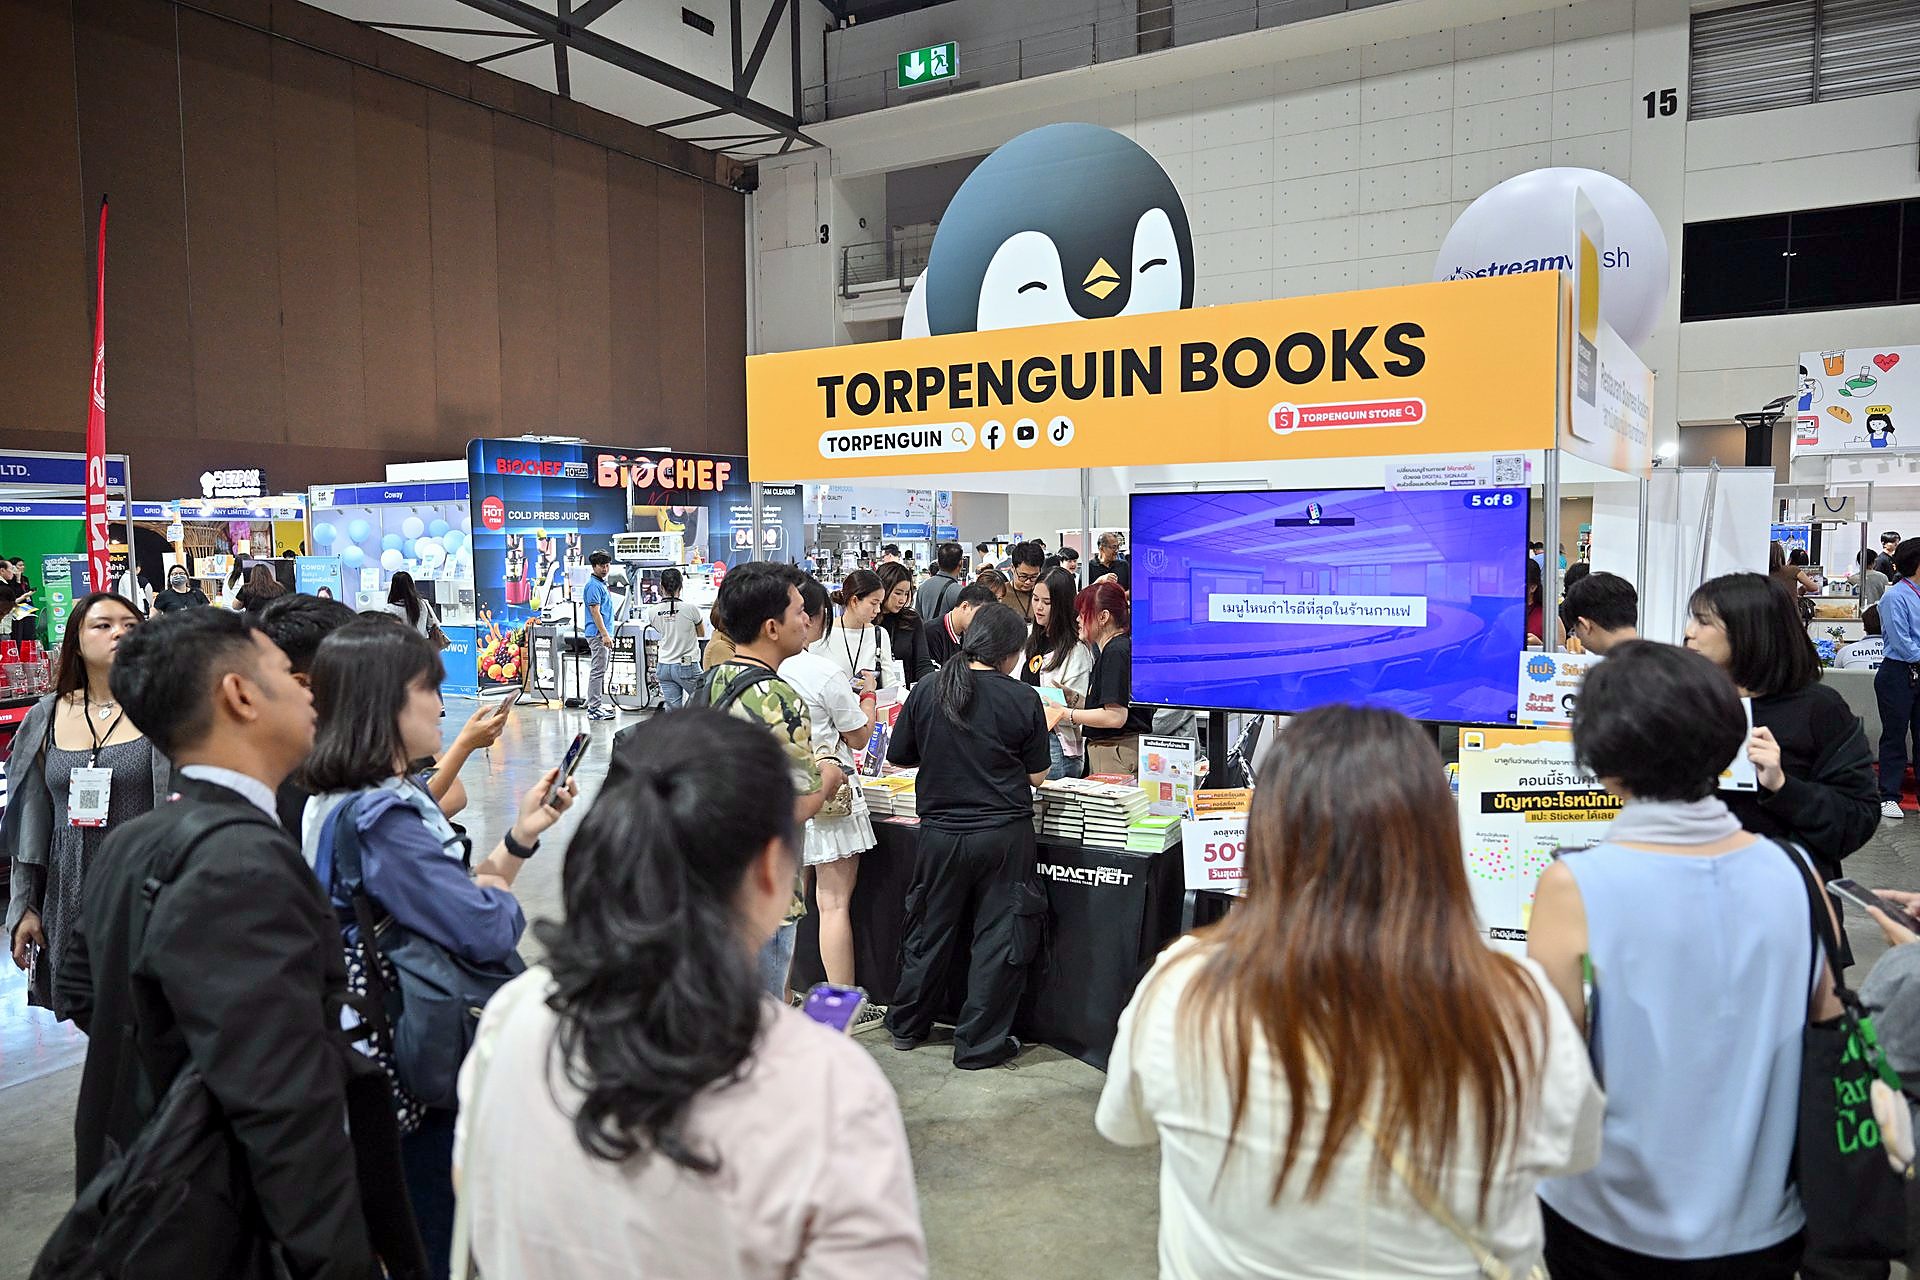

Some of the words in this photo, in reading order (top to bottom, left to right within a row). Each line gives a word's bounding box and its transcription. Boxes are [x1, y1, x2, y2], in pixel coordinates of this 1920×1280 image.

[1642, 87, 1678, 119] 15
[820, 224, 830, 245] 3
[817, 345, 1162, 419] TORPENGUIN
[1180, 321, 1427, 393] BOOKS
[1302, 410, 1368, 423] TORPENGUIN
[1368, 408, 1402, 419] STORE
[827, 430, 942, 453] TORPENGUIN
[0, 464, 31, 476] LTD.
[384, 491, 403, 499] Coway
[773, 488, 796, 496] CLEANER
[1471, 494, 1481, 506] 5
[1484, 494, 1500, 506] of
[1502, 494, 1513, 506] 8
[483, 508, 503, 517] HOT
[508, 511, 532, 520] COLD
[533, 511, 560, 520] PRESS
[561, 512, 590, 521] JUICER
[1222, 598, 1411, 620] เมนูไหนกำไรดีที่สุดในร้านกาแฟ
[1852, 649, 1884, 657] CHAM
[1529, 662, 1553, 674] แปะ
[1531, 811, 1547, 821] แปะ
[1550, 812, 1584, 821] Sticker
[1587, 810, 1615, 820] ได้เลย
[1036, 862, 1096, 881] IMPACT
